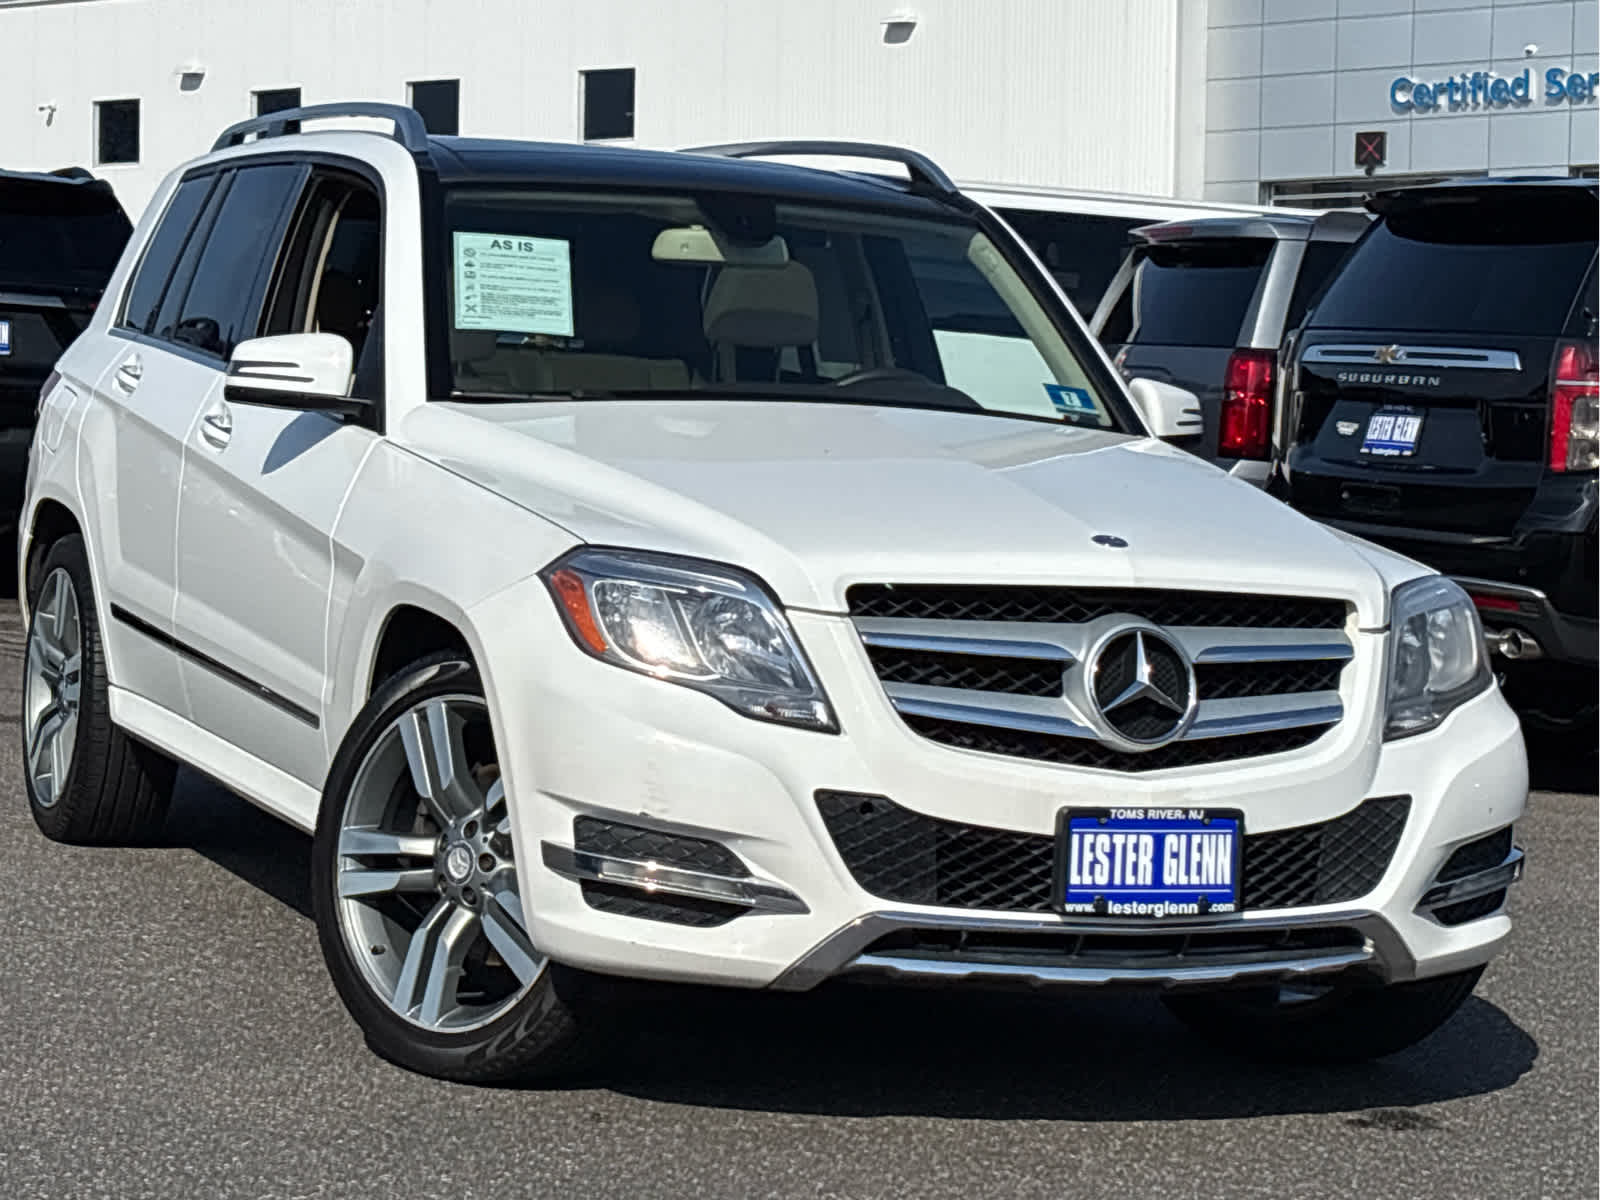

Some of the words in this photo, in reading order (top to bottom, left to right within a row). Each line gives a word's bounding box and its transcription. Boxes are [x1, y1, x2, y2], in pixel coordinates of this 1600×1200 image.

[1390, 67, 1531, 108] Certified
[490, 239, 513, 250] AS
[518, 241, 534, 253] IS
[1337, 372, 1440, 386] SUBURBAN
[1110, 808, 1145, 819] TOMS
[1188, 810, 1205, 820] NJ
[1069, 833, 1154, 886] LESTER
[1162, 833, 1233, 886] GLENN
[1107, 900, 1199, 918] lesterglenn
[1207, 902, 1235, 913] .com
